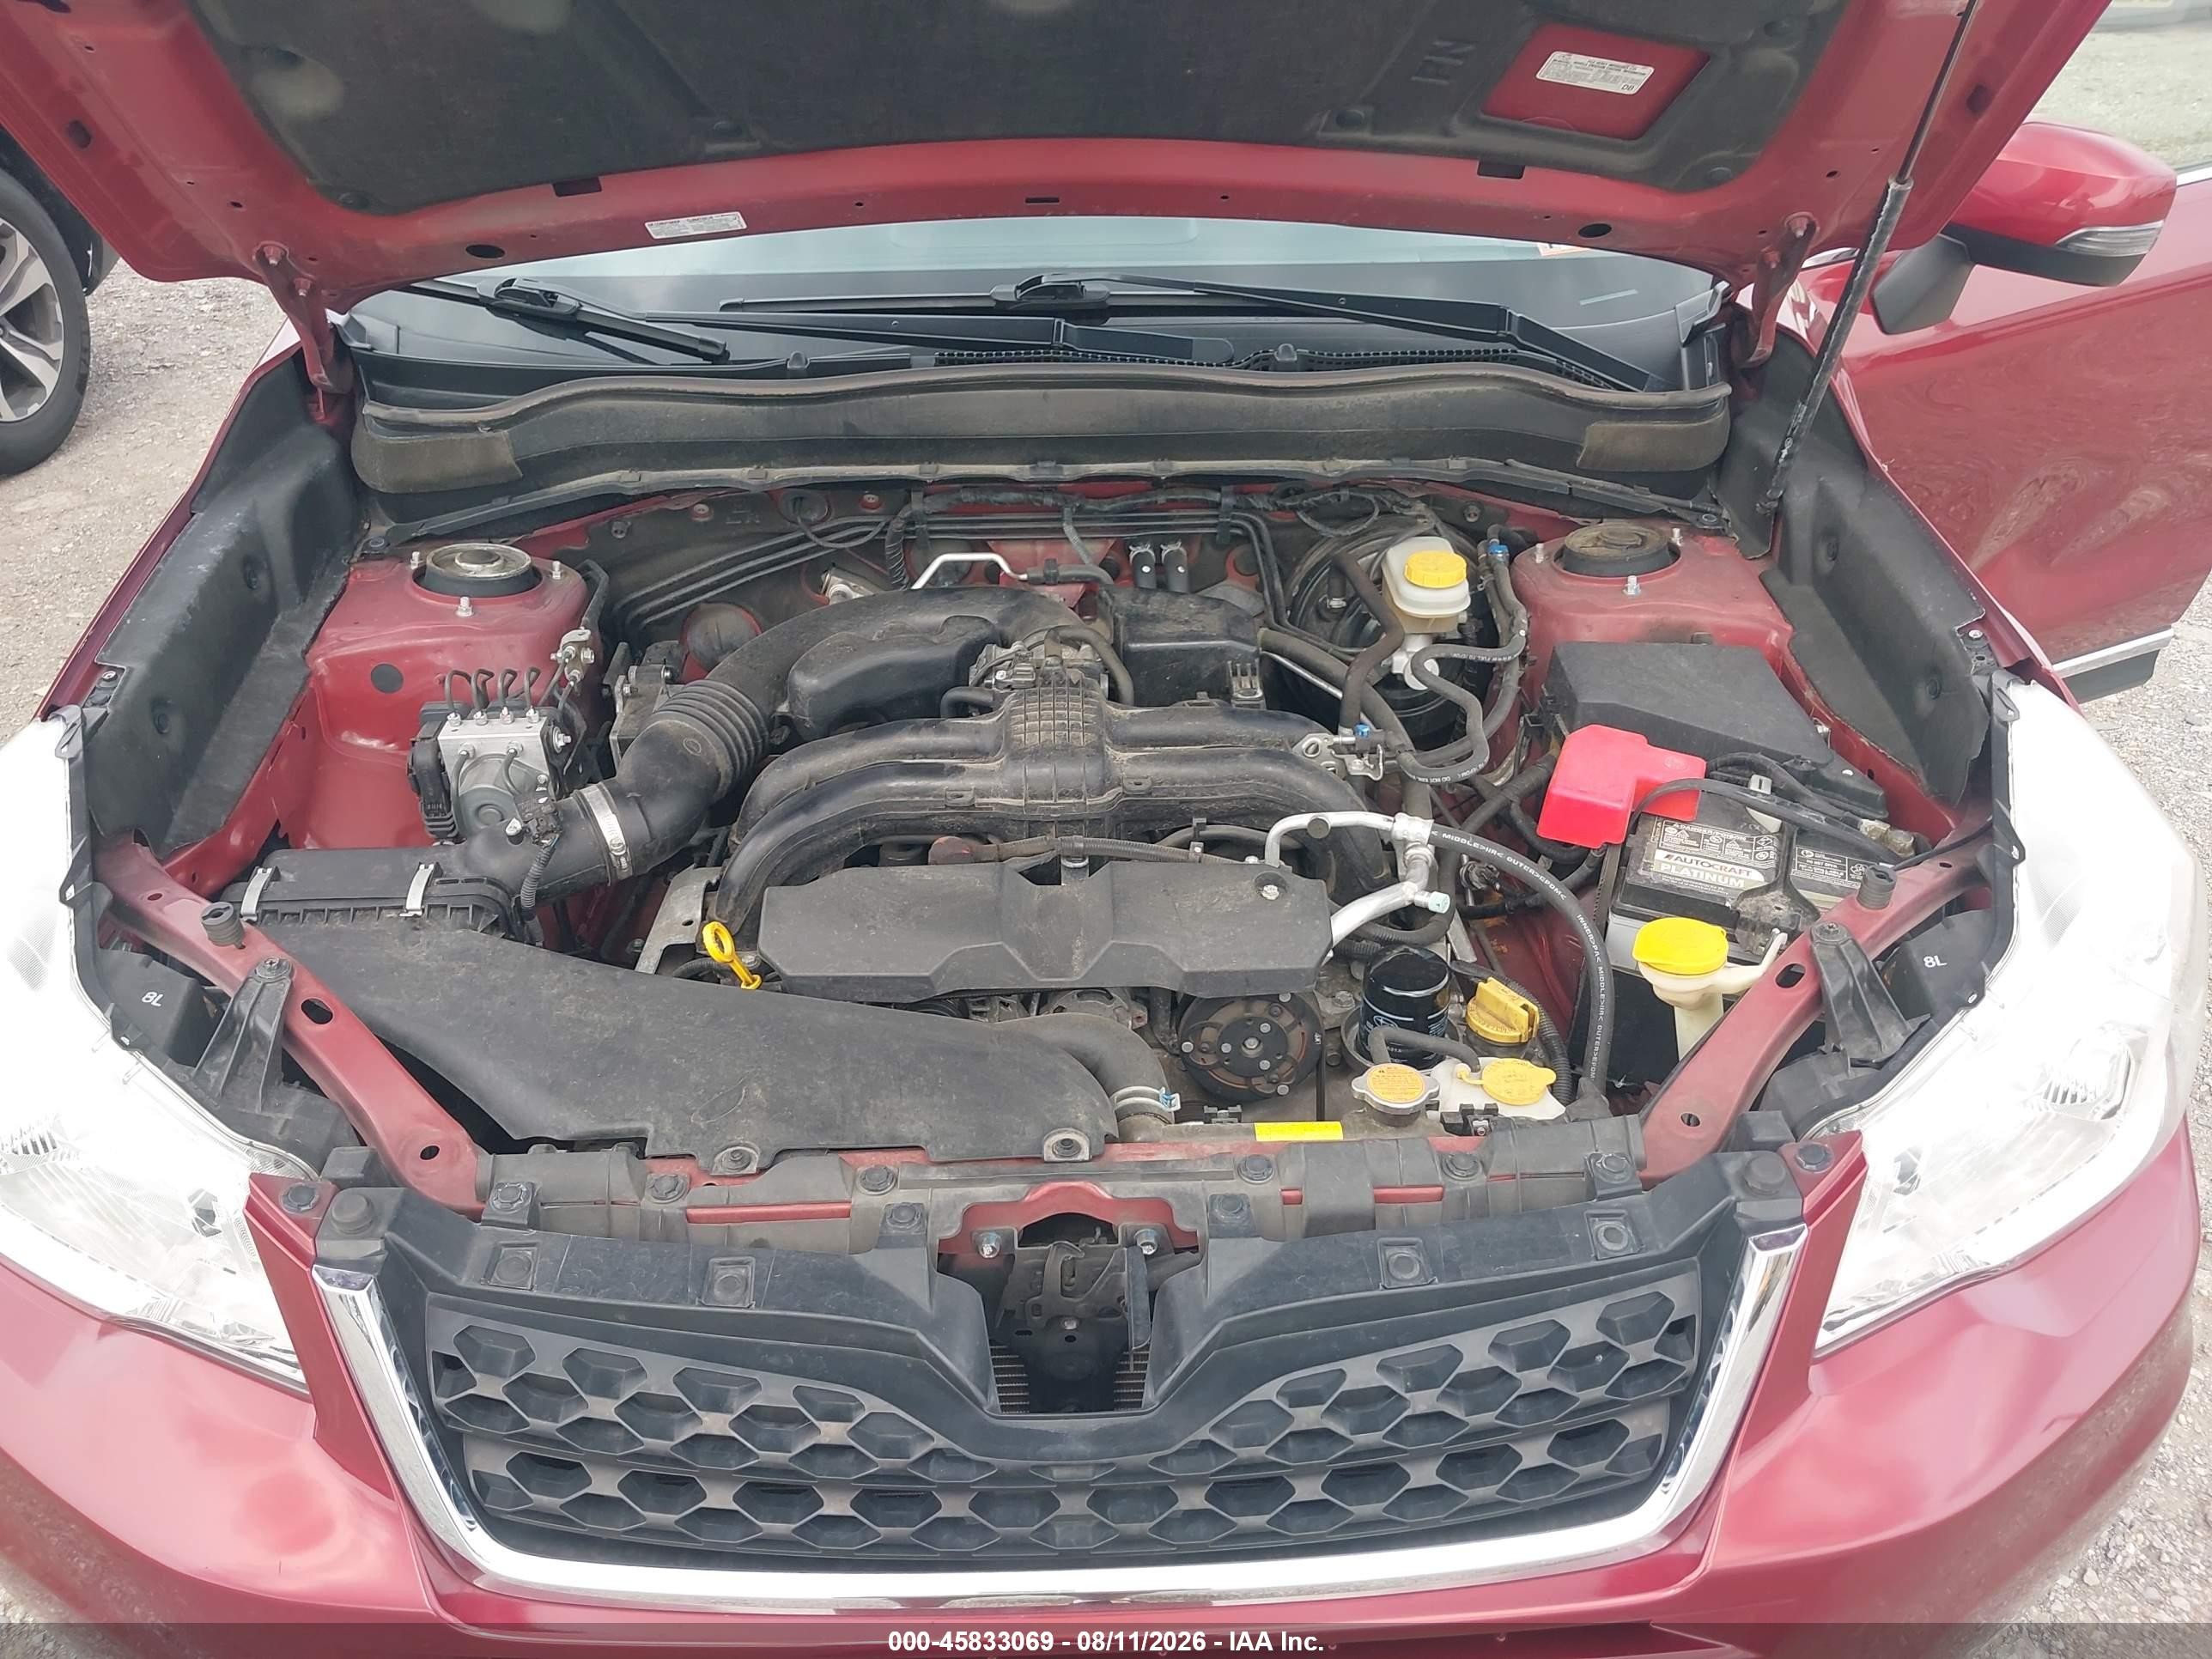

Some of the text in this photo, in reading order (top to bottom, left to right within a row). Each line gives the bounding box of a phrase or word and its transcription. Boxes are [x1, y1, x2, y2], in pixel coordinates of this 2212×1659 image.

[1660, 863, 1745, 888] PLATINUM
[1923, 955, 1948, 968] 8L
[141, 991, 164, 1007] 8L
